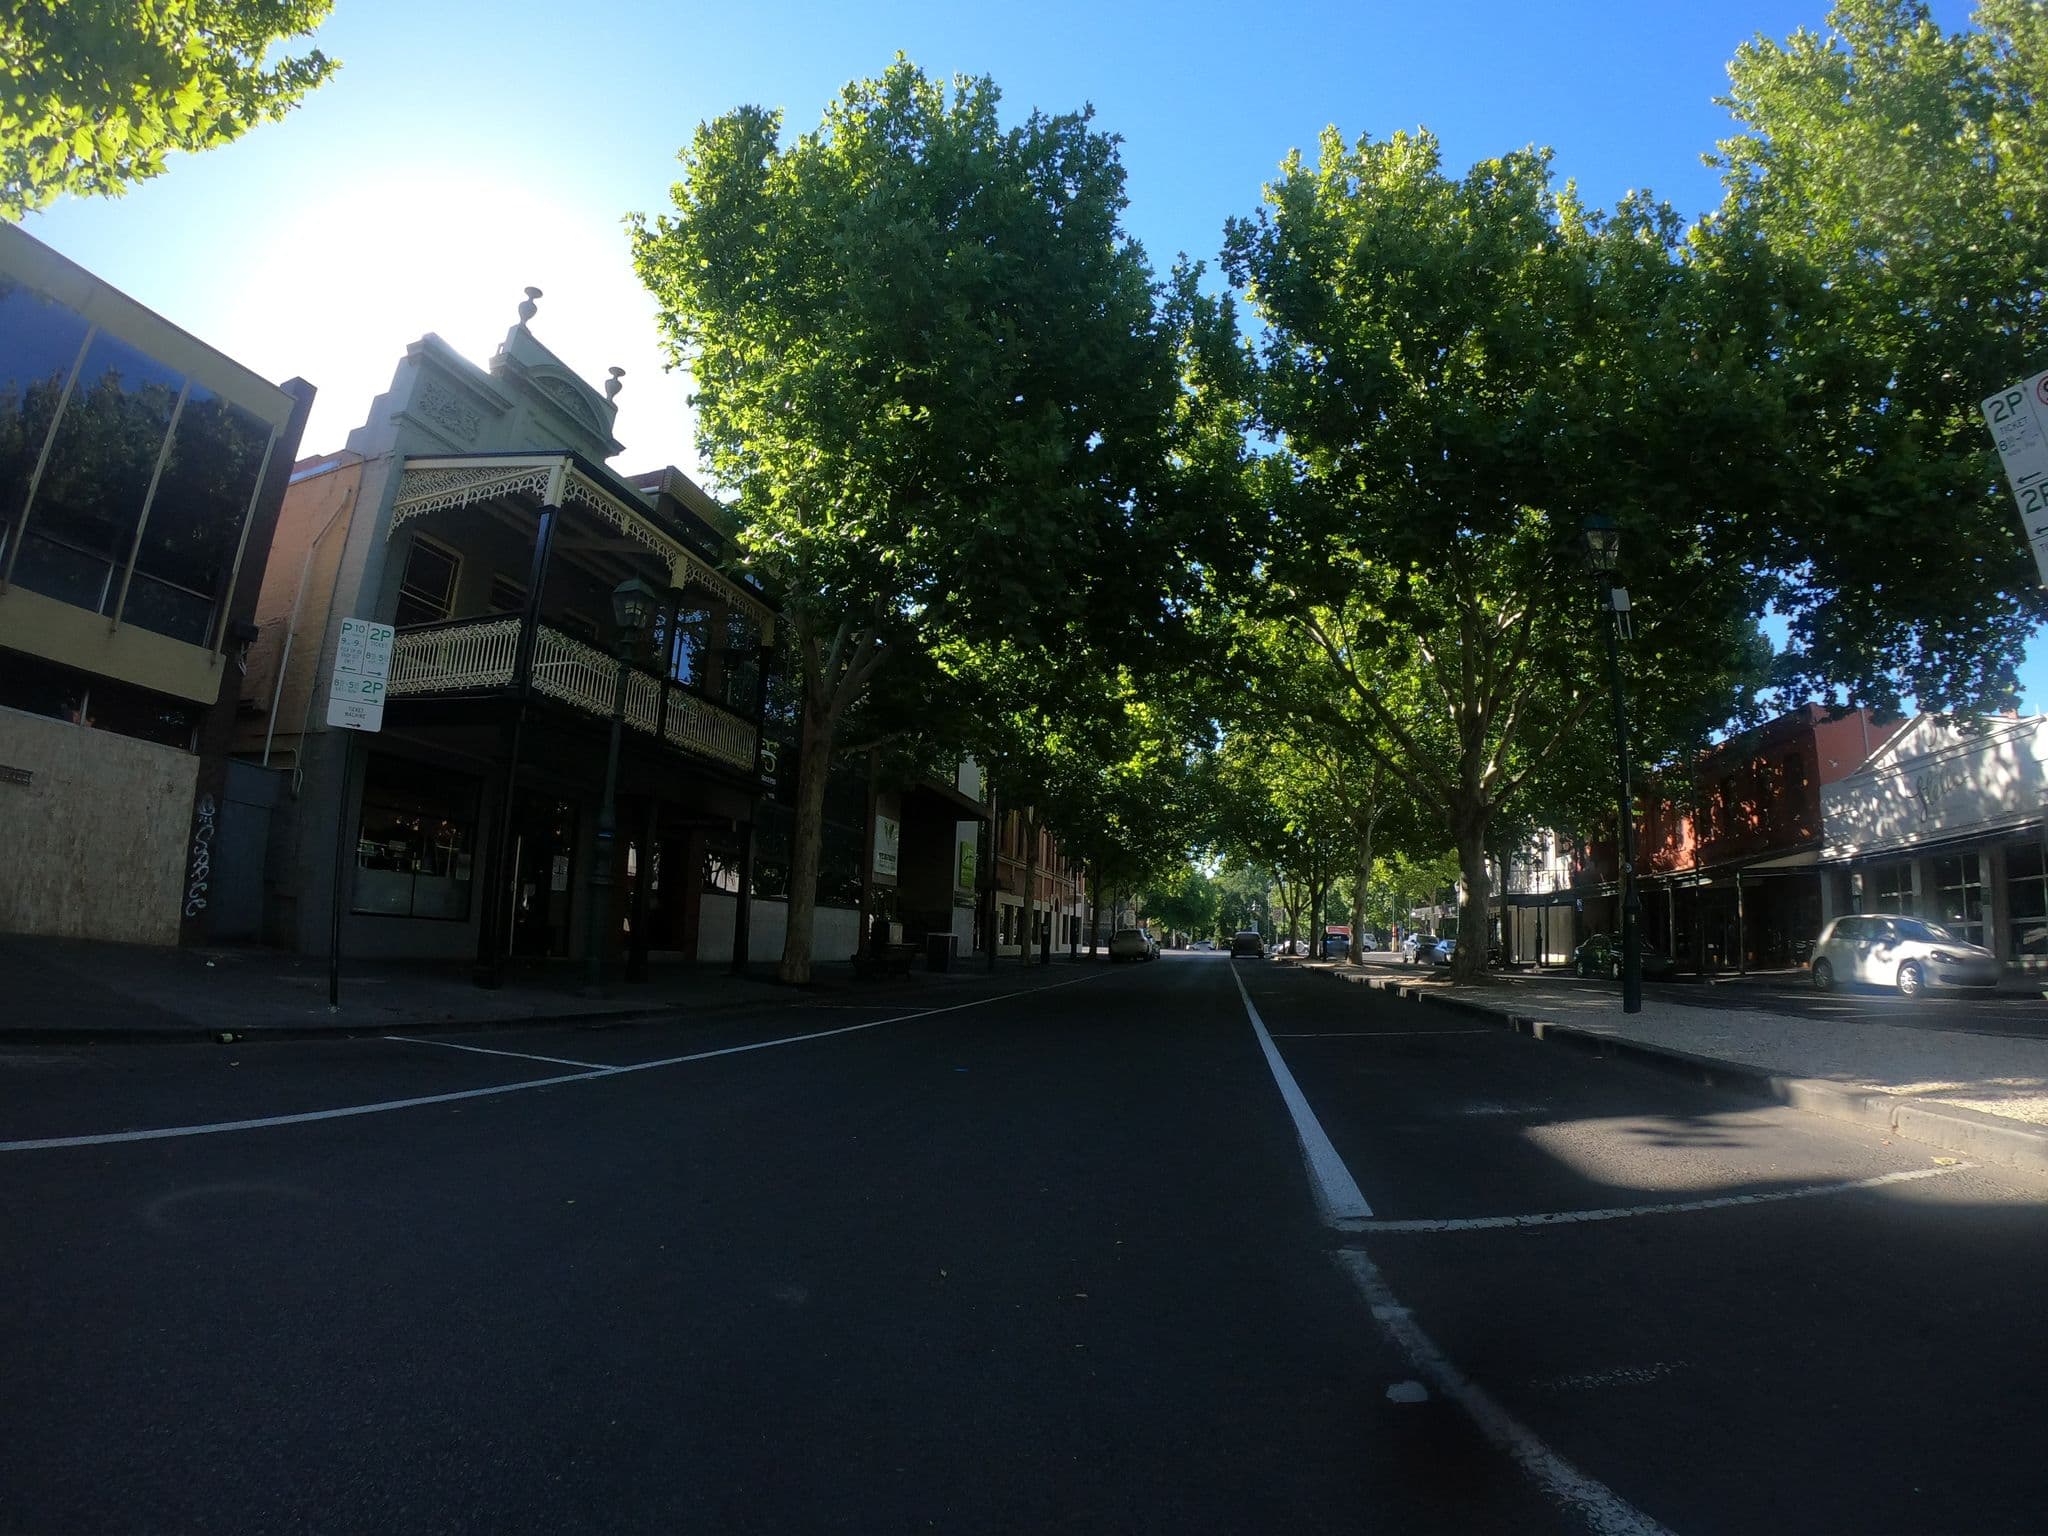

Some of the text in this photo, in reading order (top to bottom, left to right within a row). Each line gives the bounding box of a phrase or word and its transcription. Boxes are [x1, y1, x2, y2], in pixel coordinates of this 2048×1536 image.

[1988, 391, 2022, 424] 2P
[1999, 415, 2030, 435] TICKET
[342, 622, 365, 634] P 10
[370, 628, 391, 641] 2P
[362, 680, 383, 694] 2P
